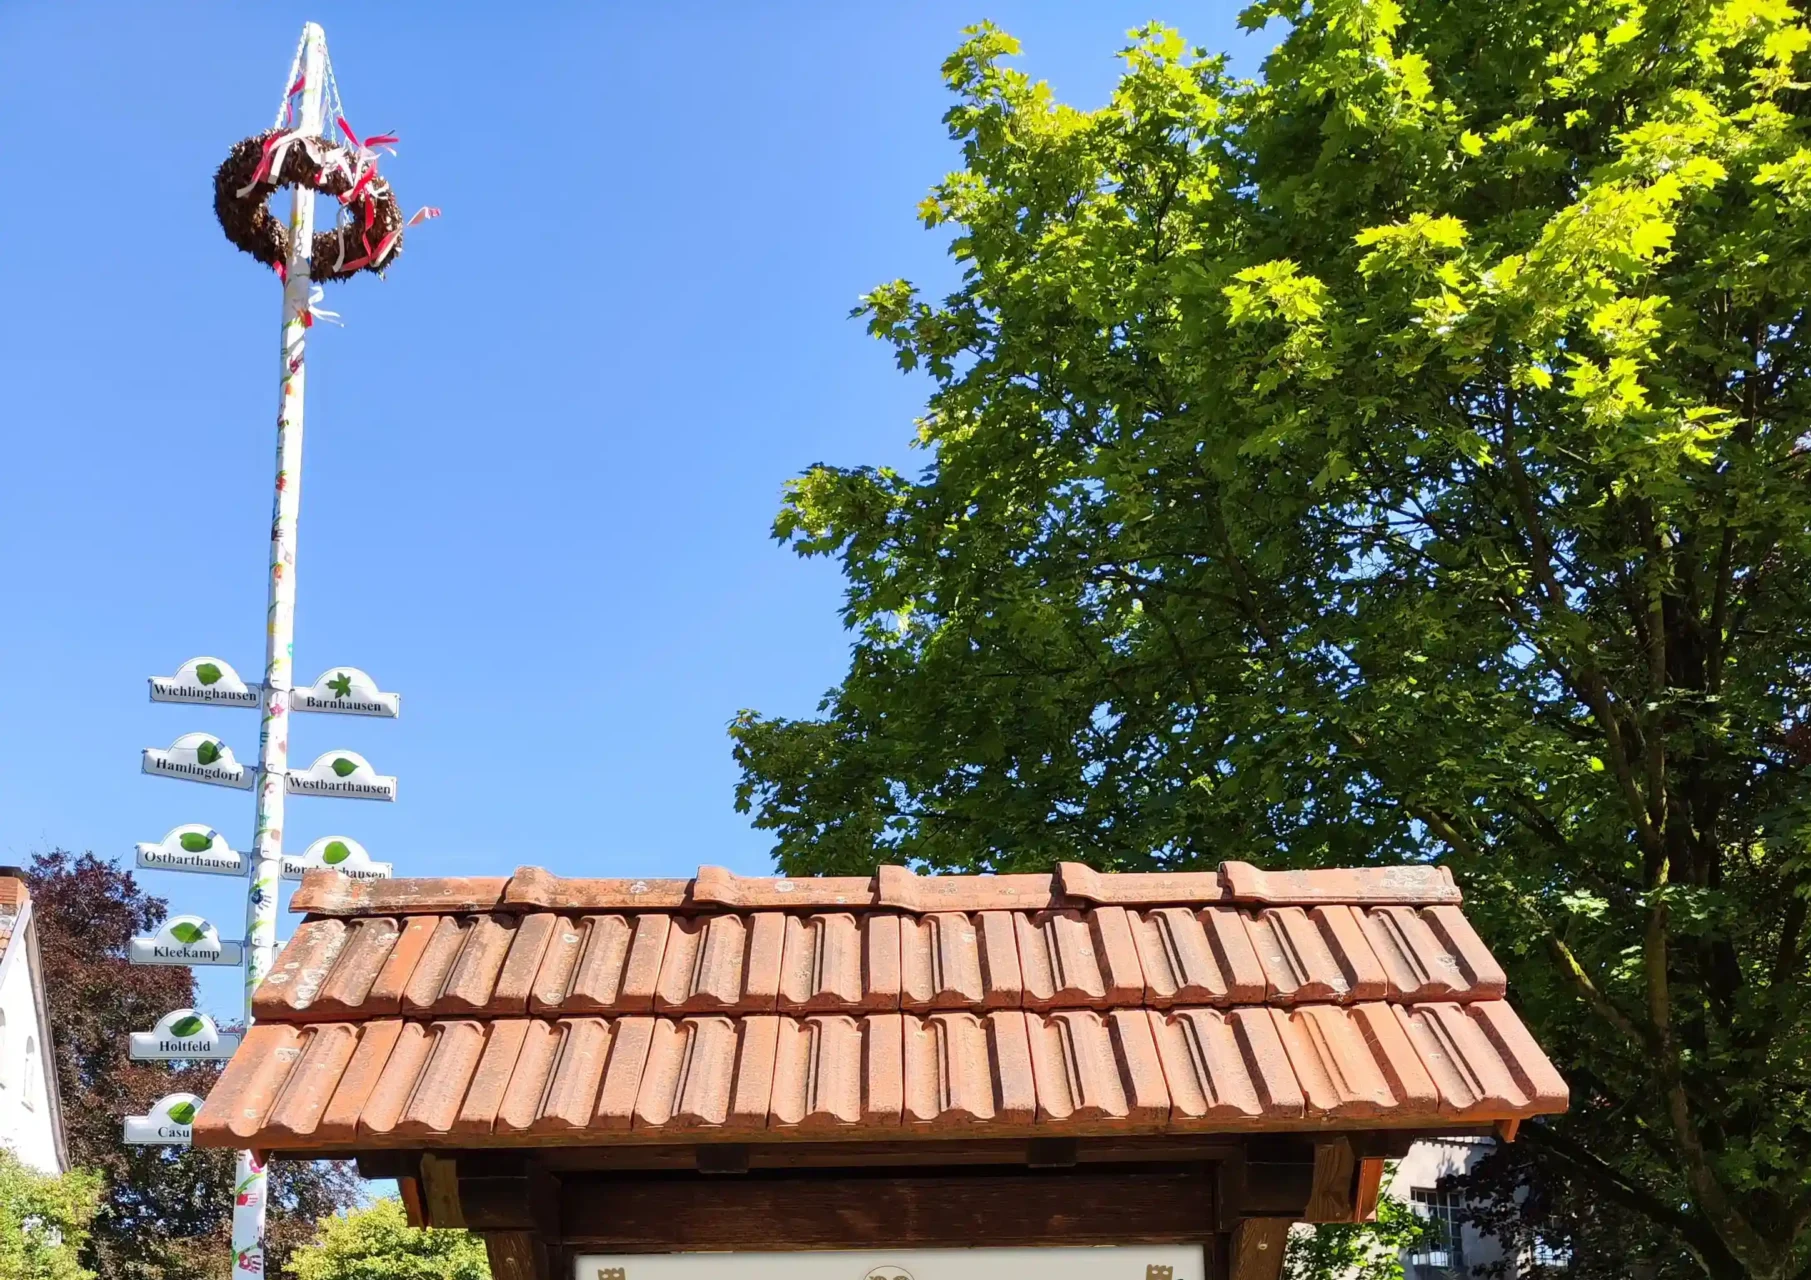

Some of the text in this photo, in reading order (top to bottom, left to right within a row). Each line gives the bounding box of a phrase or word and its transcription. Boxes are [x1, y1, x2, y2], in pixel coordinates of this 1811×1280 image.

[154, 684, 257, 702] Wichlinghausen
[306, 697, 381, 711] Barnhausen
[156, 758, 242, 782] Hamlingdorf
[290, 777, 391, 794] Westbarthausen
[145, 851, 241, 869] Ostbarthausen
[154, 947, 219, 962] Kleekamp
[159, 1041, 211, 1052] Holtfeld
[158, 1126, 190, 1138] Casu
